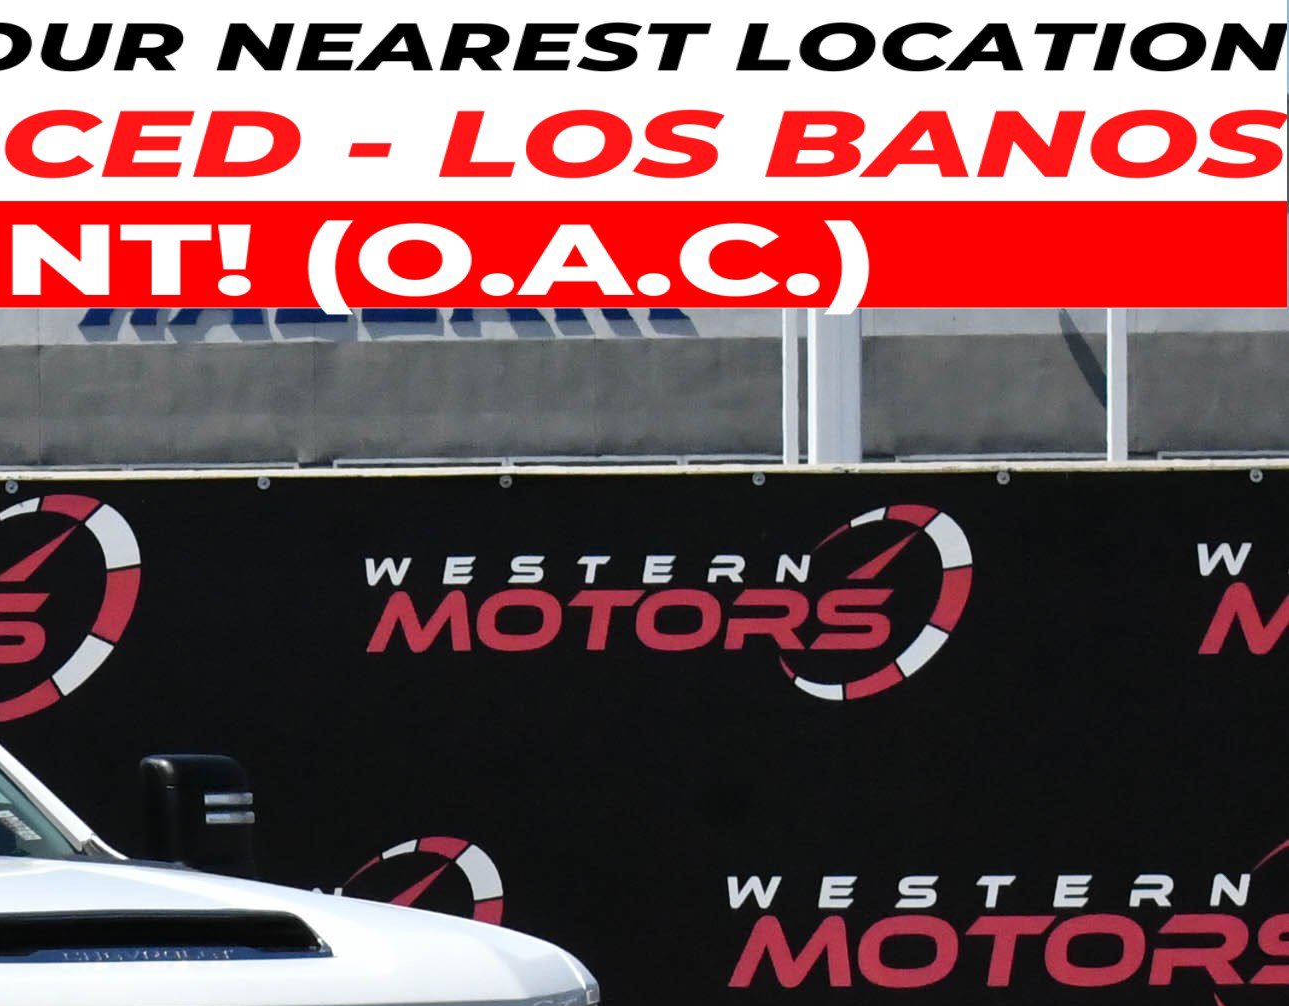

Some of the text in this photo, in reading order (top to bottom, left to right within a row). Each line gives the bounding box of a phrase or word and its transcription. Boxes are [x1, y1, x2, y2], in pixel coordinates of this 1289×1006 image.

[365, 554, 811, 586] WESTERN
[366, 589, 894, 653] MOTORS
[727, 873, 1251, 909] WESTERN
